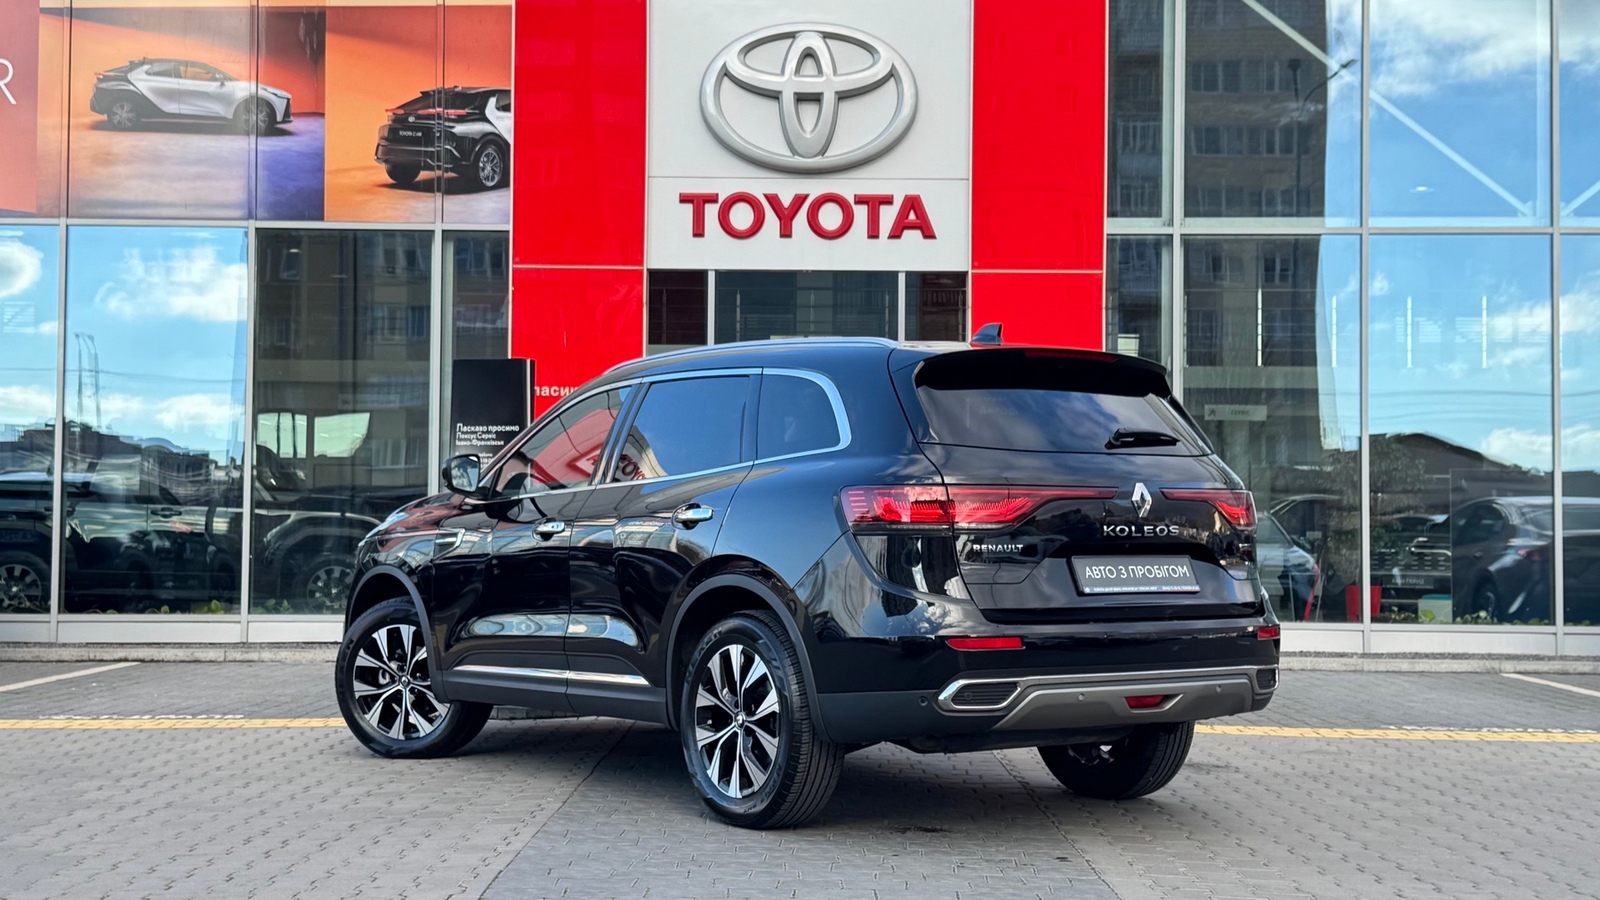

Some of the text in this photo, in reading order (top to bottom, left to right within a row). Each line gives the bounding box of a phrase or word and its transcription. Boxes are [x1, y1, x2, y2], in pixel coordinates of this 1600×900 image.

[679, 191, 937, 240] TOYOTA
[456, 423, 520, 433] Ласкаво просимо
[477, 432, 496, 440] Сервіс
[1103, 525, 1180, 537] KOLEOS
[973, 544, 1024, 553] RENAULT
[1085, 565, 1117, 579] АВТО
[1128, 565, 1190, 579] ПРОБІГОМ
